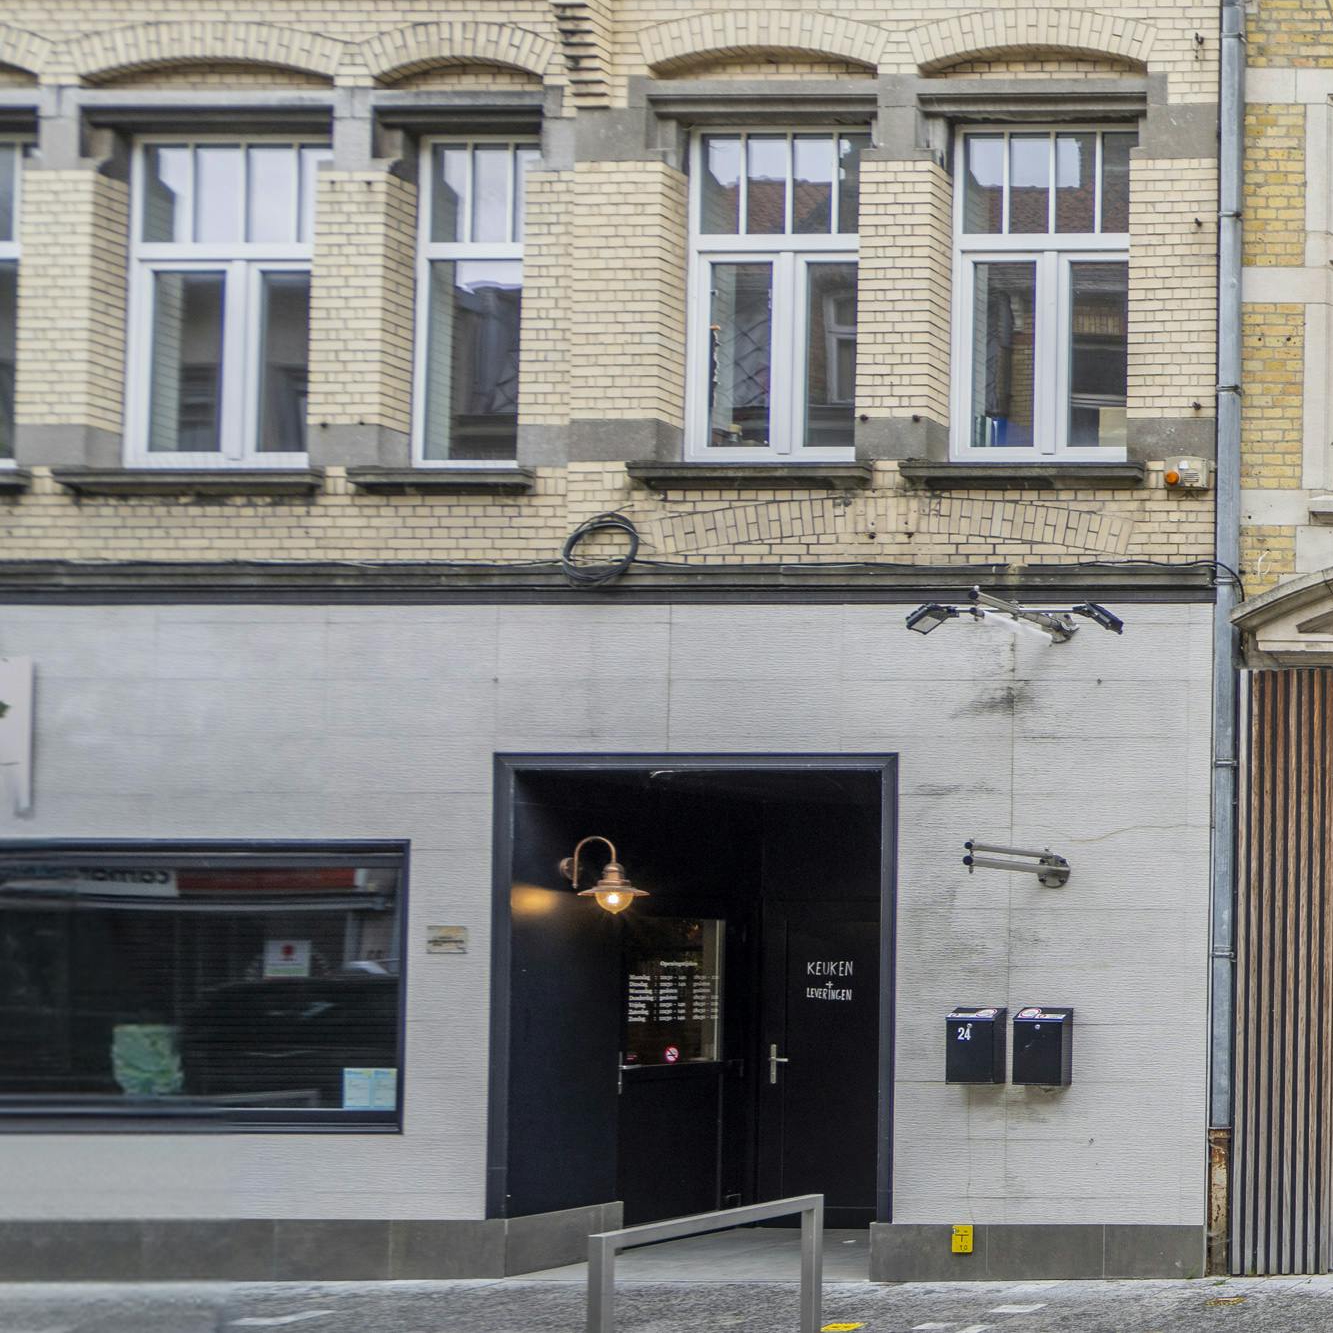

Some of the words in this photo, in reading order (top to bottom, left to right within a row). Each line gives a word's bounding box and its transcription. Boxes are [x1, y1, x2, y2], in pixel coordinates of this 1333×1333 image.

[807, 961, 854, 976] KEUKEN
[806, 987, 853, 1001] LEVERINGEN
[957, 1027, 971, 1041] 24
